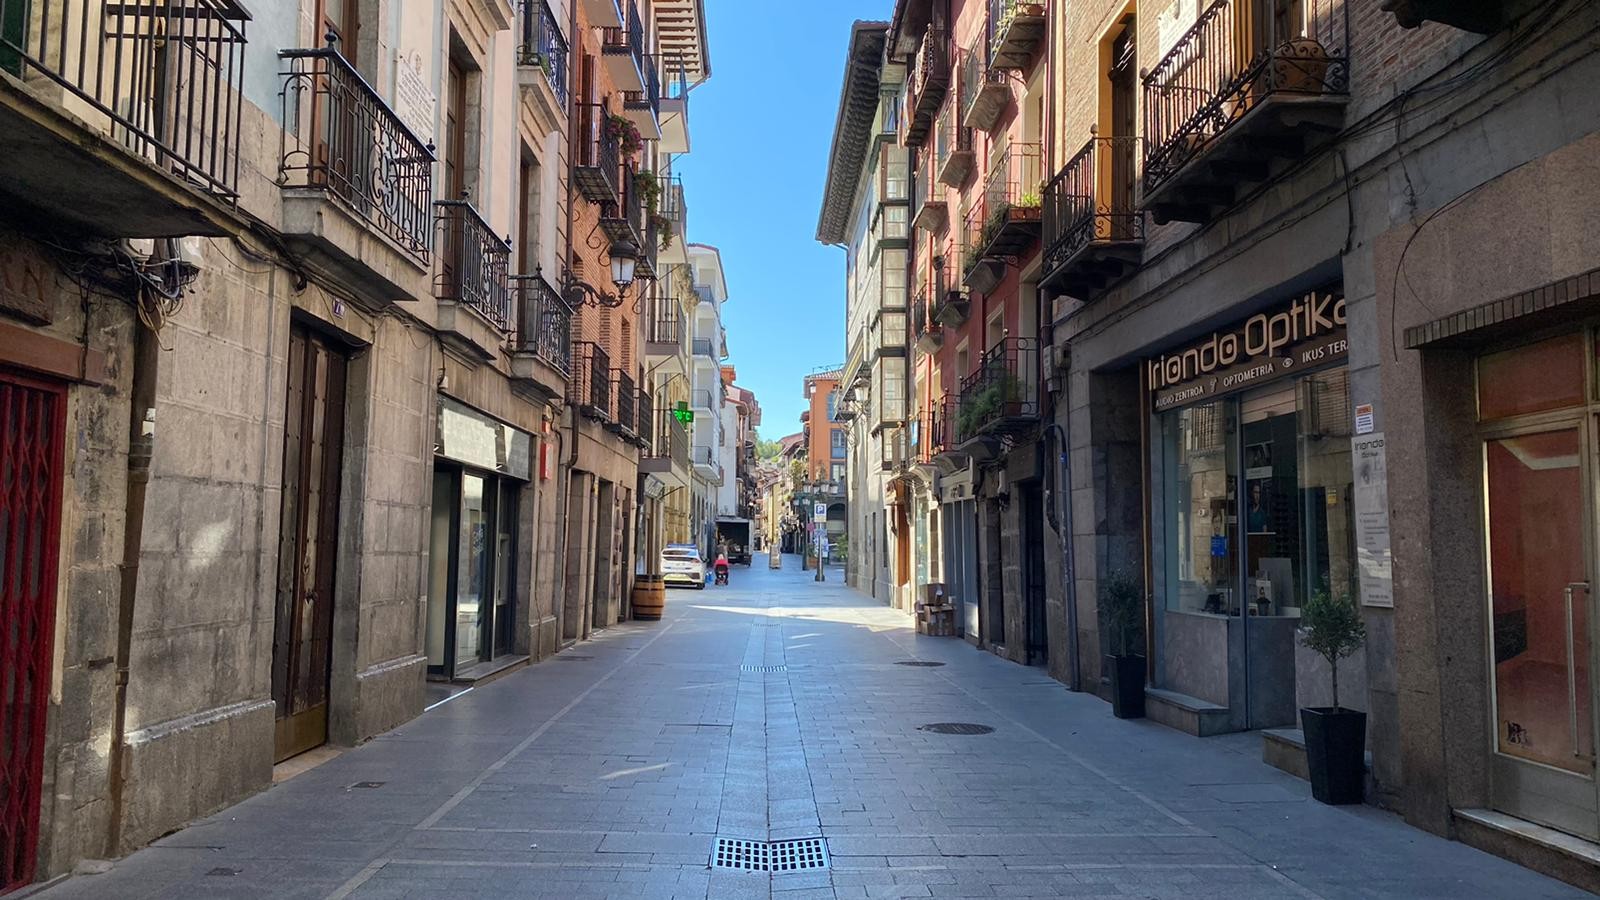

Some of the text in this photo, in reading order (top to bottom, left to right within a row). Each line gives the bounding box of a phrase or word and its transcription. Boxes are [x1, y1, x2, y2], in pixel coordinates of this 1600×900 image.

[1148, 332, 1237, 391] Iriondo
[1155, 339, 1349, 408] AUDIO ZENTROA OPTOMETRIA IKUS TER
